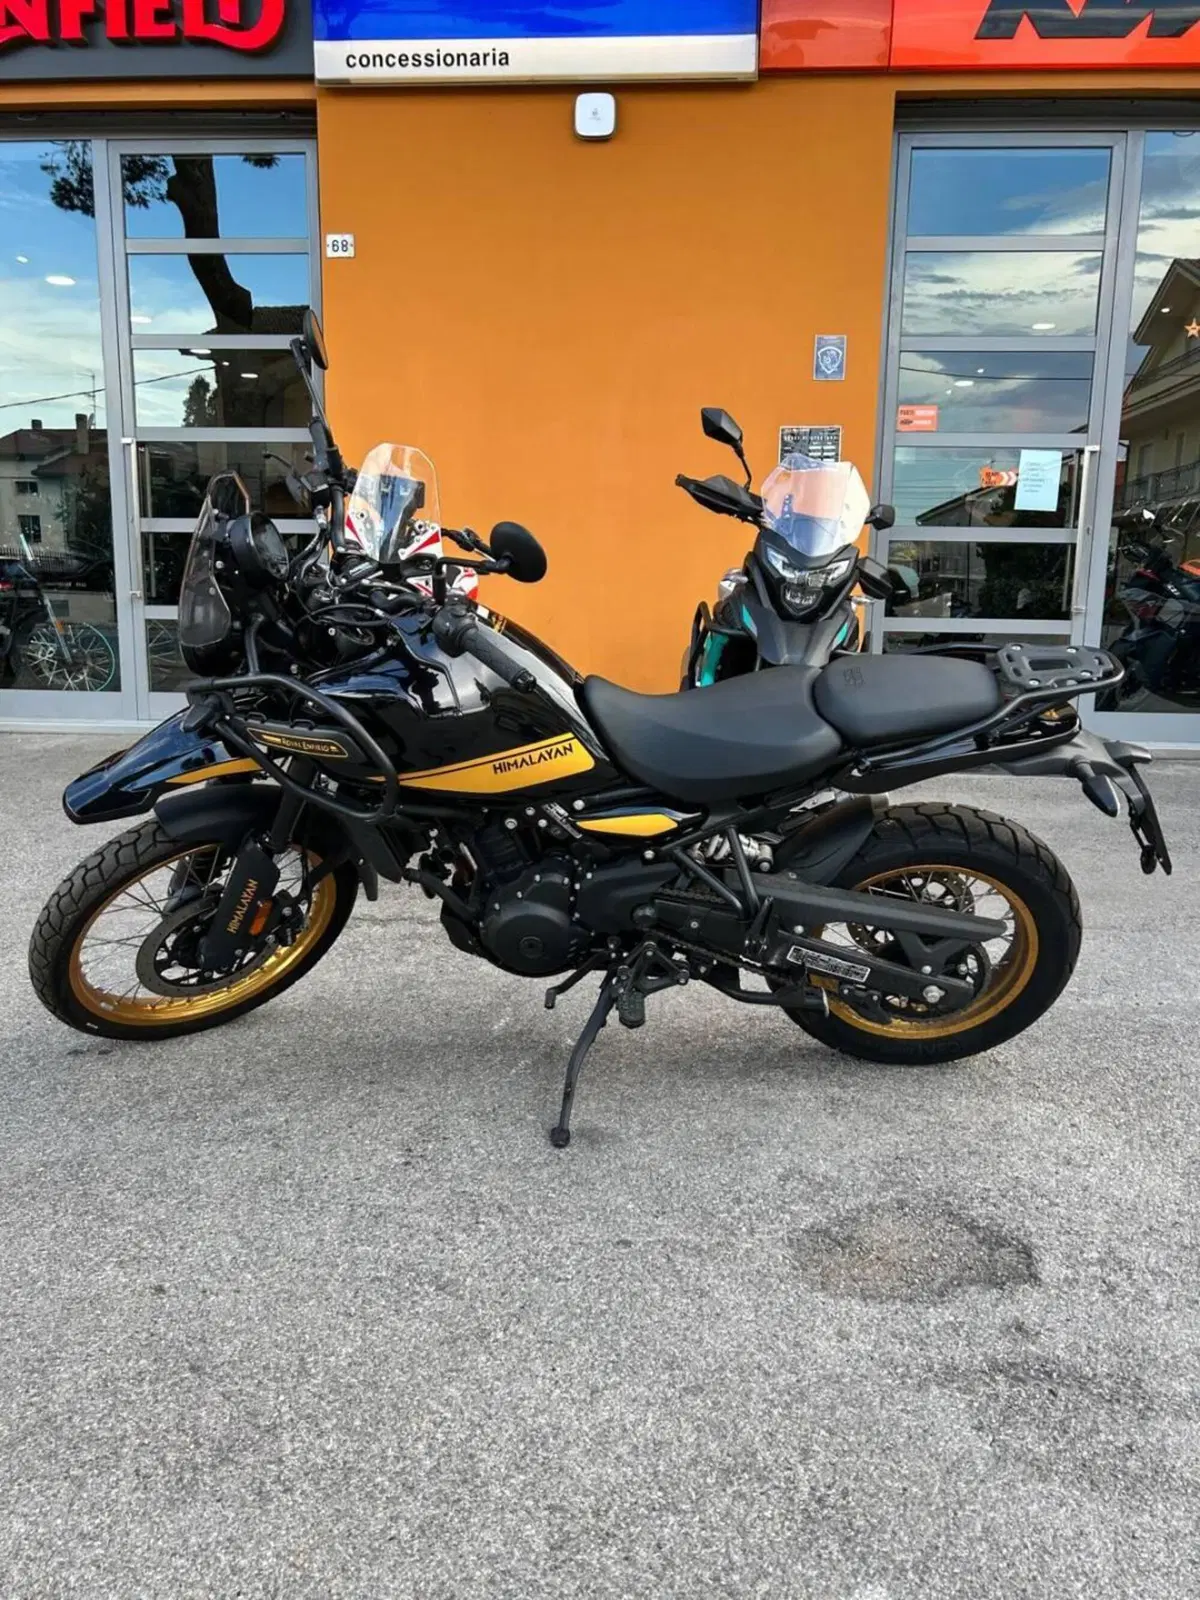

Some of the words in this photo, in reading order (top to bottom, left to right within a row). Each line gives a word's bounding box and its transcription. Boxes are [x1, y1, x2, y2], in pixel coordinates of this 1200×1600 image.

[346, 48, 510, 68] concessionaria
[331, 239, 349, 252] 68
[492, 743, 574, 774] HIMALAYAN
[226, 878, 259, 934] HIMALAYAN
